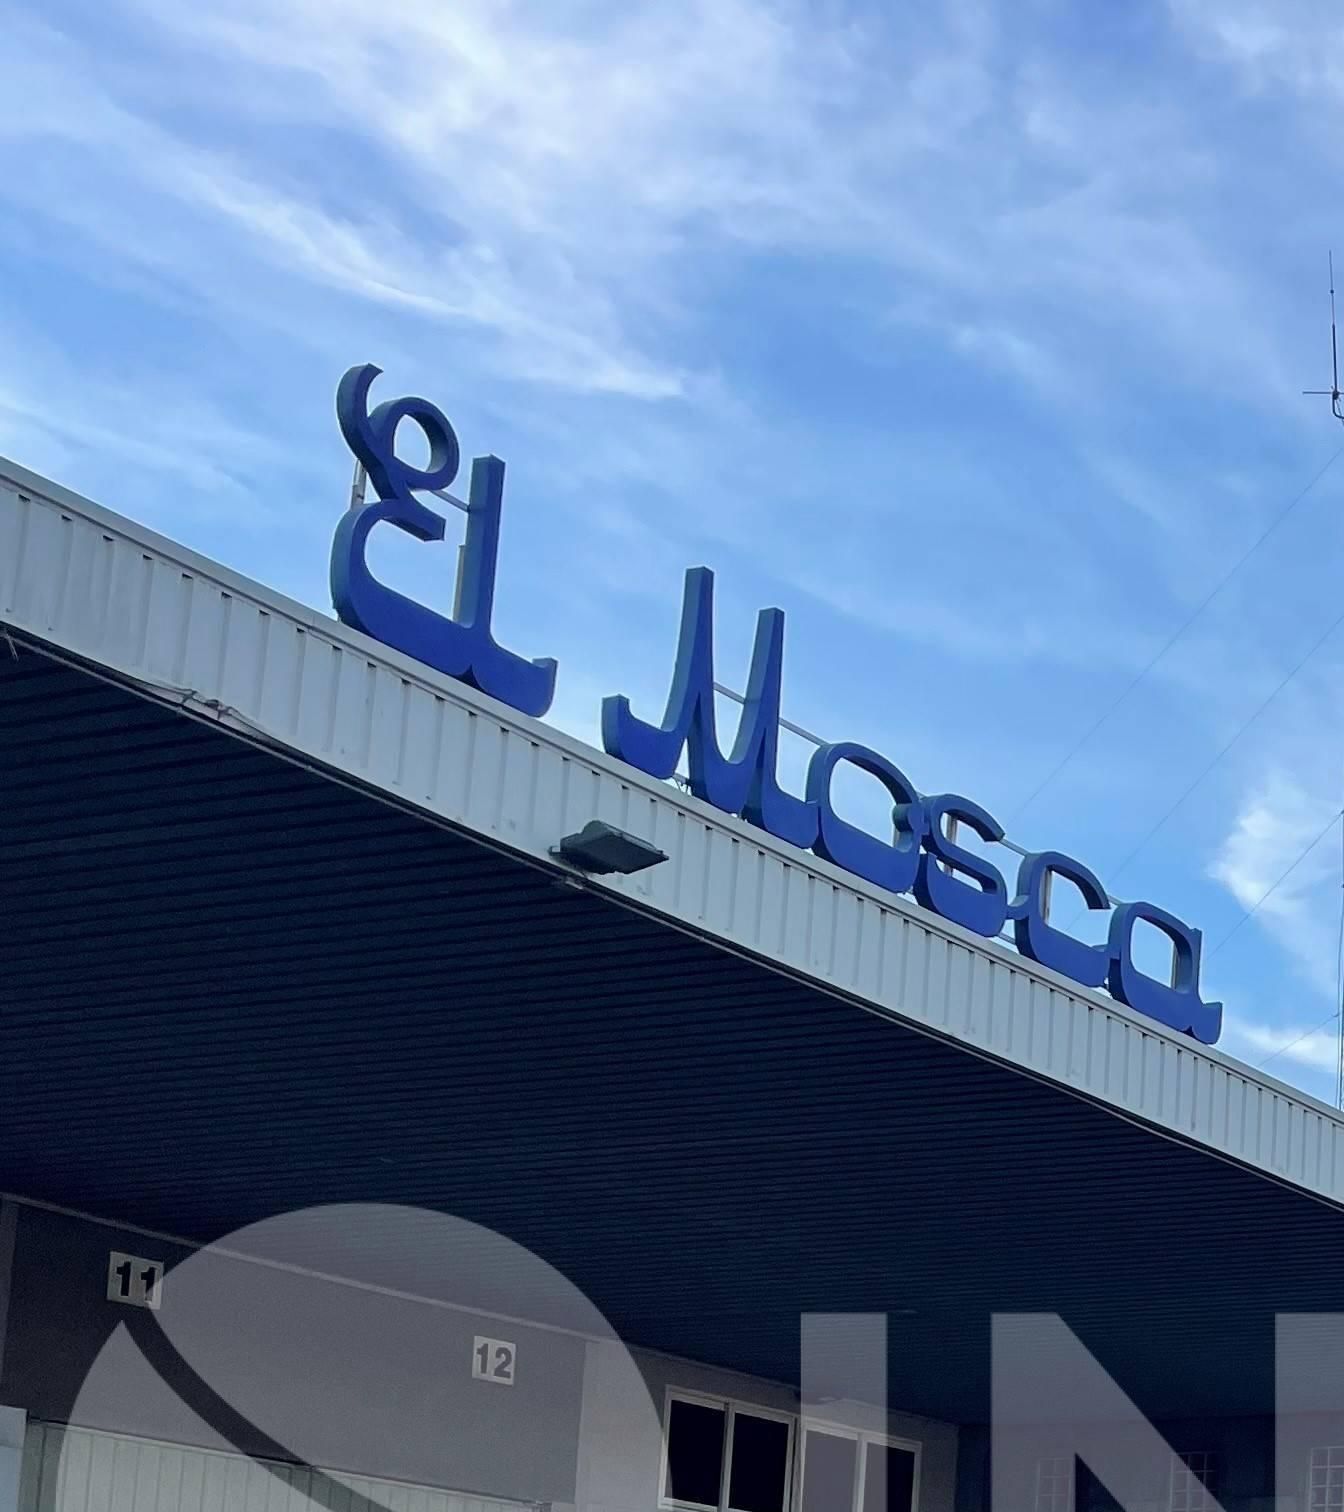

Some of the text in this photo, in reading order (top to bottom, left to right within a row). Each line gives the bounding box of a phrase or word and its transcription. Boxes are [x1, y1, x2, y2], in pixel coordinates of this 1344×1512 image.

[330, 363, 1222, 1045] El Mosca
[116, 1261, 156, 1301] 11
[477, 1343, 513, 1379] 12
